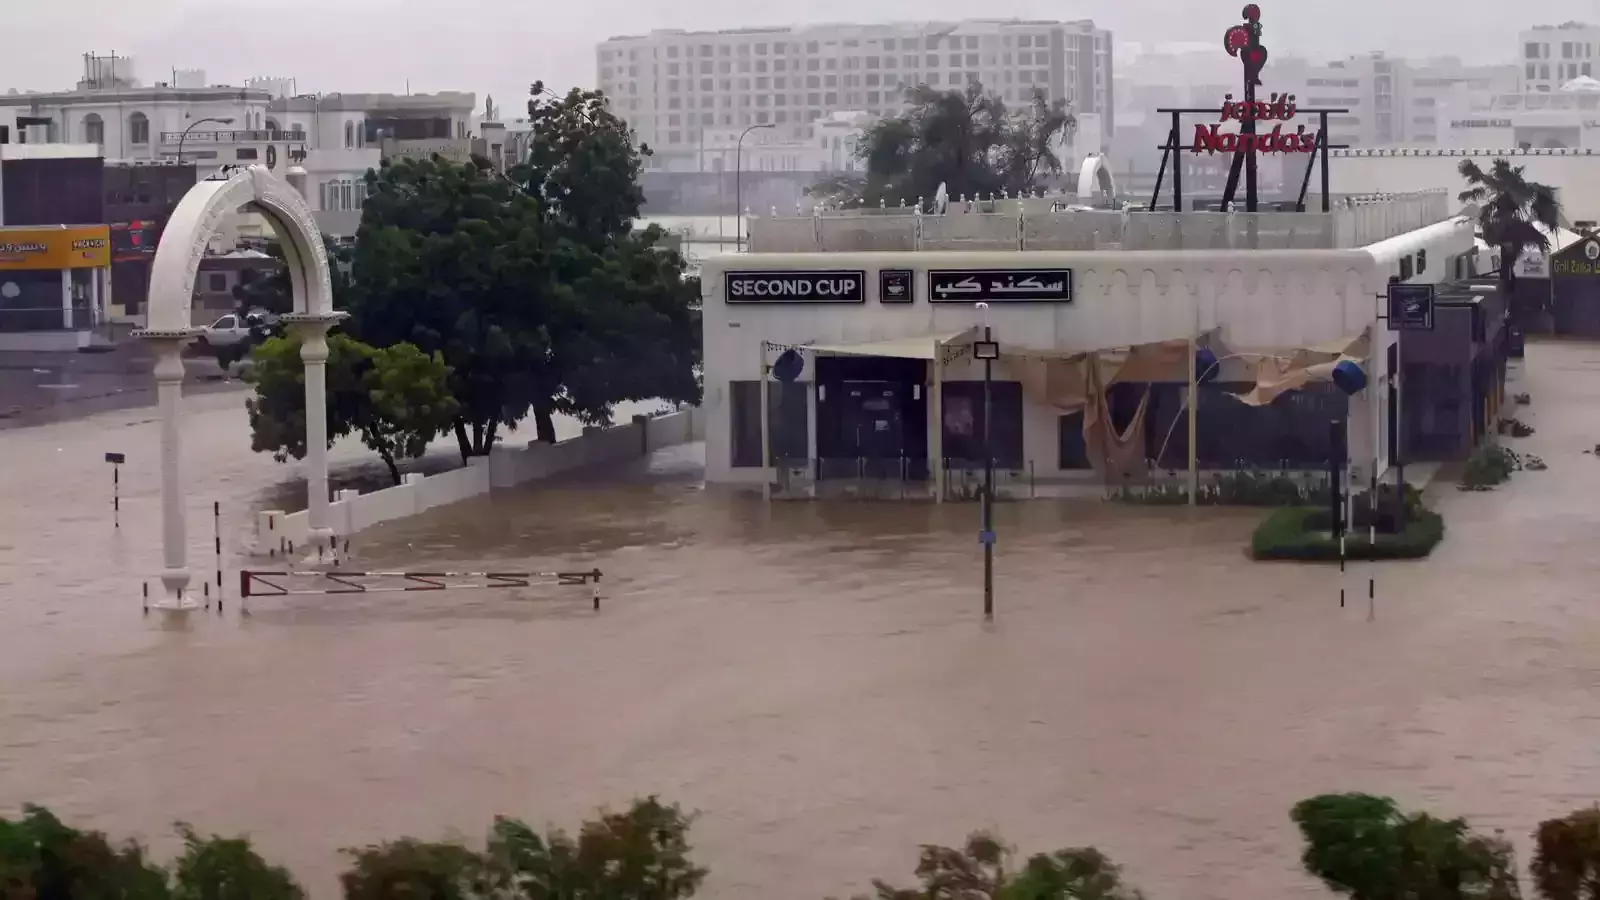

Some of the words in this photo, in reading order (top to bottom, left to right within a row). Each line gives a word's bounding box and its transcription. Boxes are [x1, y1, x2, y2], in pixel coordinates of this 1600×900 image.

[1190, 123, 1315, 155] Nando's
[1553, 259, 1569, 273] Grill
[731, 279, 812, 296] SECOND
[815, 279, 856, 295] CUP
[935, 276, 982, 298] كب
[989, 275, 1063, 292] سكند
